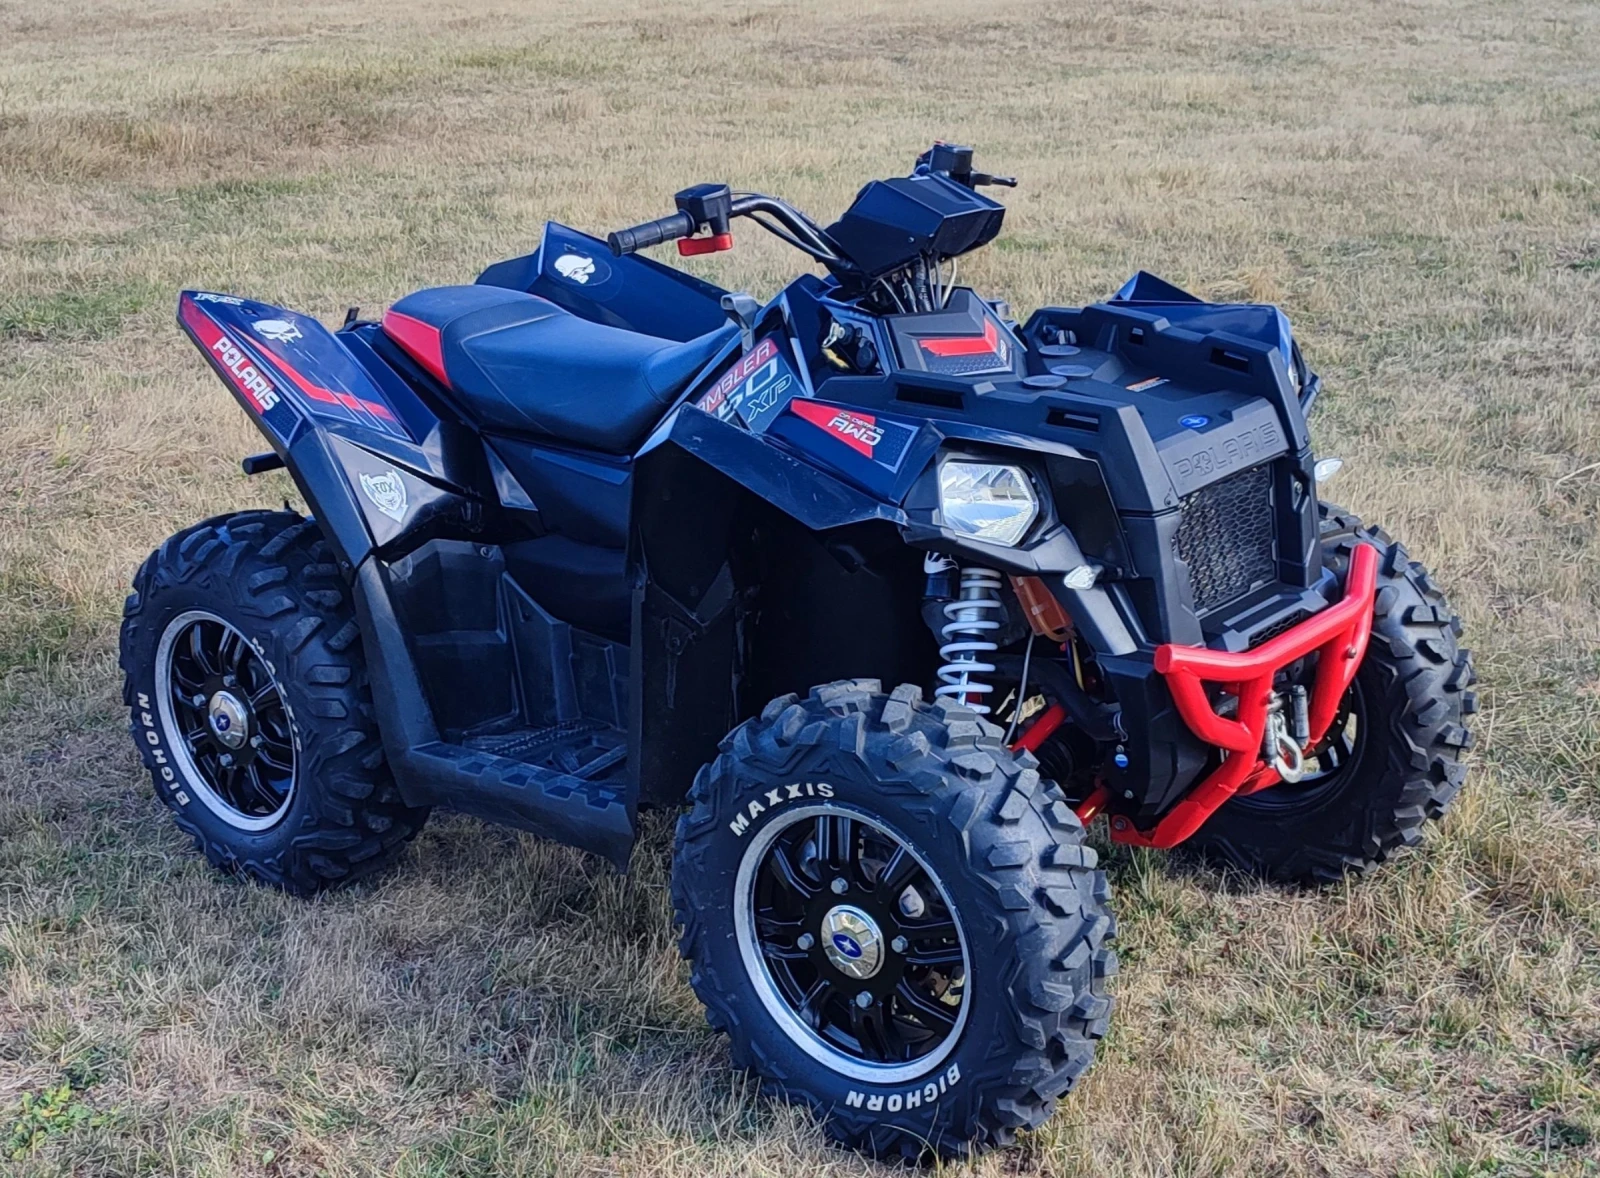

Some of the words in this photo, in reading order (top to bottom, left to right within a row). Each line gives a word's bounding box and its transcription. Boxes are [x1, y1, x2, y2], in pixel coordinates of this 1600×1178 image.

[212, 336, 280, 411] POLARIS
[748, 373, 793, 423] XP
[827, 416, 883, 447] AWD
[1173, 421, 1279, 477] POLARIS
[372, 481, 396, 494] FOX
[137, 692, 191, 807] BIGHORN
[728, 781, 836, 838] MAXXIS
[844, 1061, 961, 1113] BIGHORN
